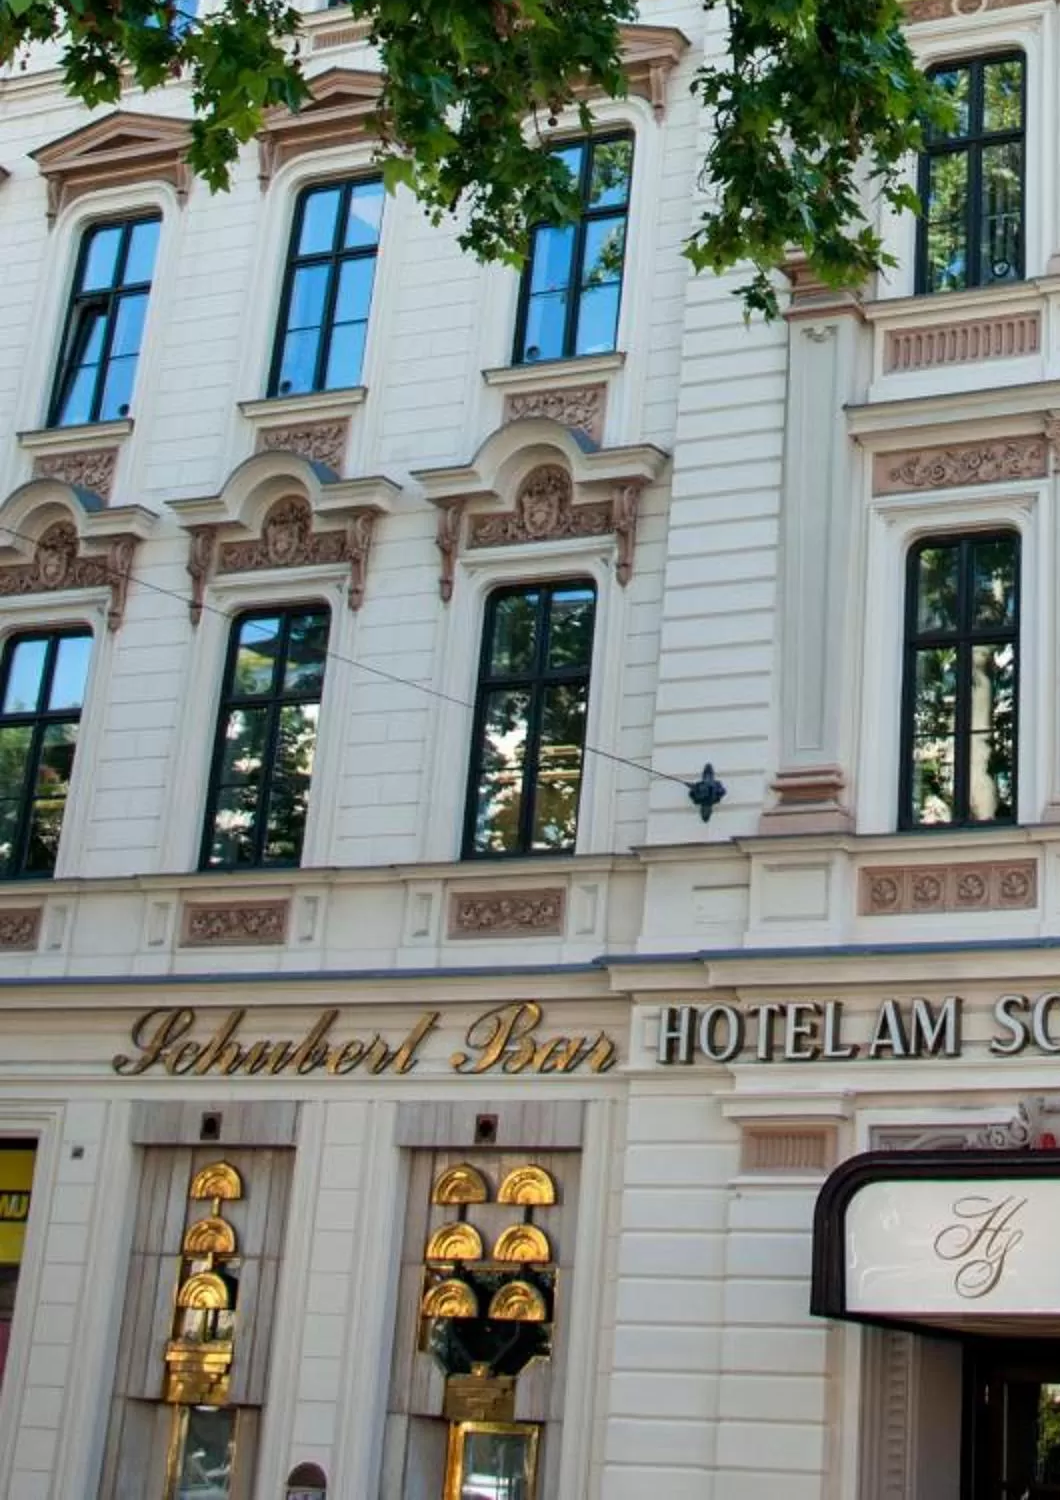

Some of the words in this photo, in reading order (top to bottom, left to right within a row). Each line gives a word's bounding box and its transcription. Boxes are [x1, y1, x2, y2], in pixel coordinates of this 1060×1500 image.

[112, 1005, 441, 1076] Schubert
[449, 999, 619, 1076] Bar
[656, 1003, 859, 1066] HOTEL
[868, 995, 963, 1060] AM
